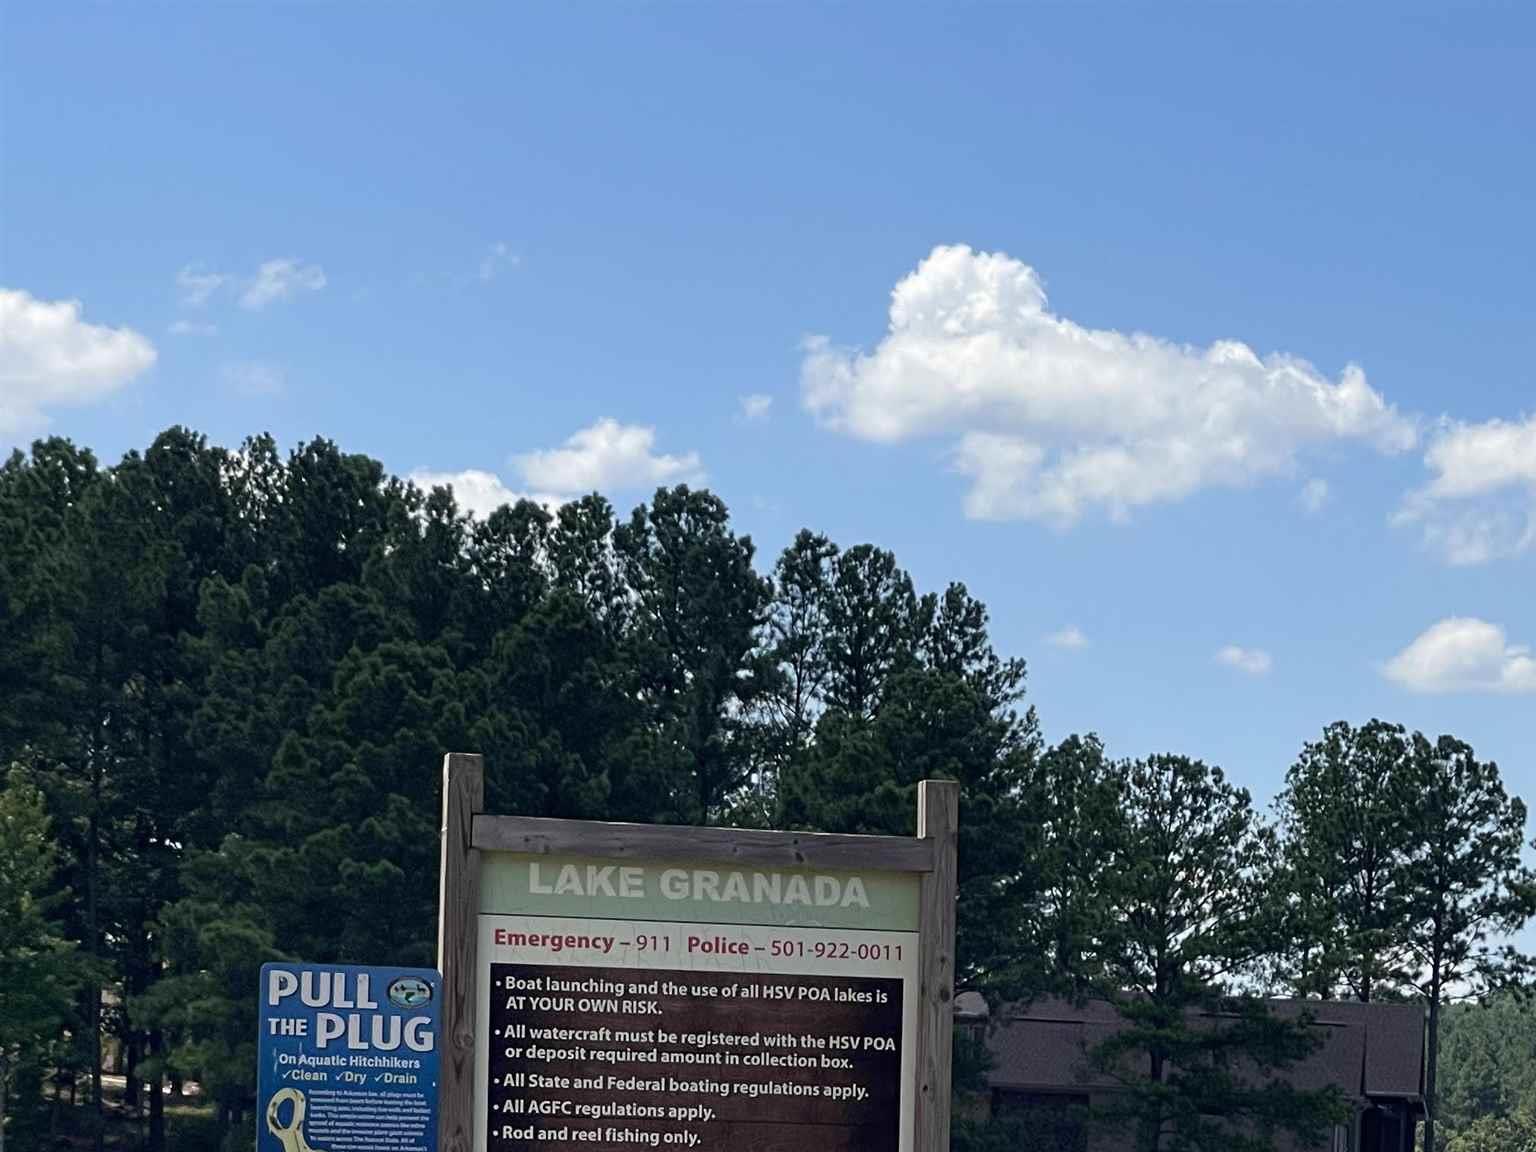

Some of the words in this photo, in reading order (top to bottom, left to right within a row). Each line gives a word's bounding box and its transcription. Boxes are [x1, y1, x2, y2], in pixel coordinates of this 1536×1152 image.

[527, 862, 645, 897] LAKE
[660, 868, 869, 907] GRANADA
[494, 928, 614, 953] Emergency
[636, 935, 671, 952] 911
[687, 936, 749, 955] Police
[771, 940, 904, 961] 501-922-0011
[269, 970, 377, 1009] PULL
[506, 976, 542, 990] Boat
[547, 977, 624, 996] launching
[629, 981, 658, 994] and
[662, 982, 687, 995] the
[692, 986, 718, 996] use
[722, 984, 738, 997] of
[741, 984, 758, 998] all
[763, 986, 794, 999] HSV
[798, 987, 830, 1000] POA
[835, 988, 872, 1002] lakes
[876, 990, 887, 1003] is
[506, 996, 526, 1009] AT
[530, 997, 574, 1011] YOUR
[578, 999, 618, 1012] OWN
[623, 1000, 662, 1014] RISK.
[268, 1017, 307, 1036] THE
[316, 1012, 434, 1052] PLUG
[504, 1025, 525, 1038] All
[530, 1027, 611, 1041] watercraft
[616, 1031, 654, 1042] must
[658, 1030, 677, 1043] be
[682, 1032, 759, 1047] registered
[764, 1034, 796, 1047] with
[801, 1034, 825, 1048] the
[830, 1036, 860, 1049] HSV
[864, 1037, 895, 1050] POA
[279, 1054, 296, 1064] On
[298, 1054, 346, 1067] Aquatic
[350, 1056, 420, 1068] Hitchhikers
[506, 1048, 522, 1058] or
[526, 1045, 586, 1062] deposit
[590, 1048, 656, 1064] required
[661, 1053, 721, 1064] amount
[726, 1052, 739, 1064] in
[744, 1052, 816, 1067] collection
[821, 1054, 852, 1068] box.
[291, 1068, 328, 1081] Clean
[345, 1071, 366, 1085] Dry
[384, 1072, 417, 1084] Drain
[503, 1100, 524, 1112] All
[528, 1100, 571, 1114] AGFC
[576, 1102, 664, 1118] regulations
[668, 1104, 715, 1121] apply.
[503, 1126, 533, 1139] Rod
[538, 1126, 567, 1140] and
[572, 1128, 601, 1141] reel
[606, 1128, 659, 1146] fishing
[664, 1130, 700, 1147] only.
